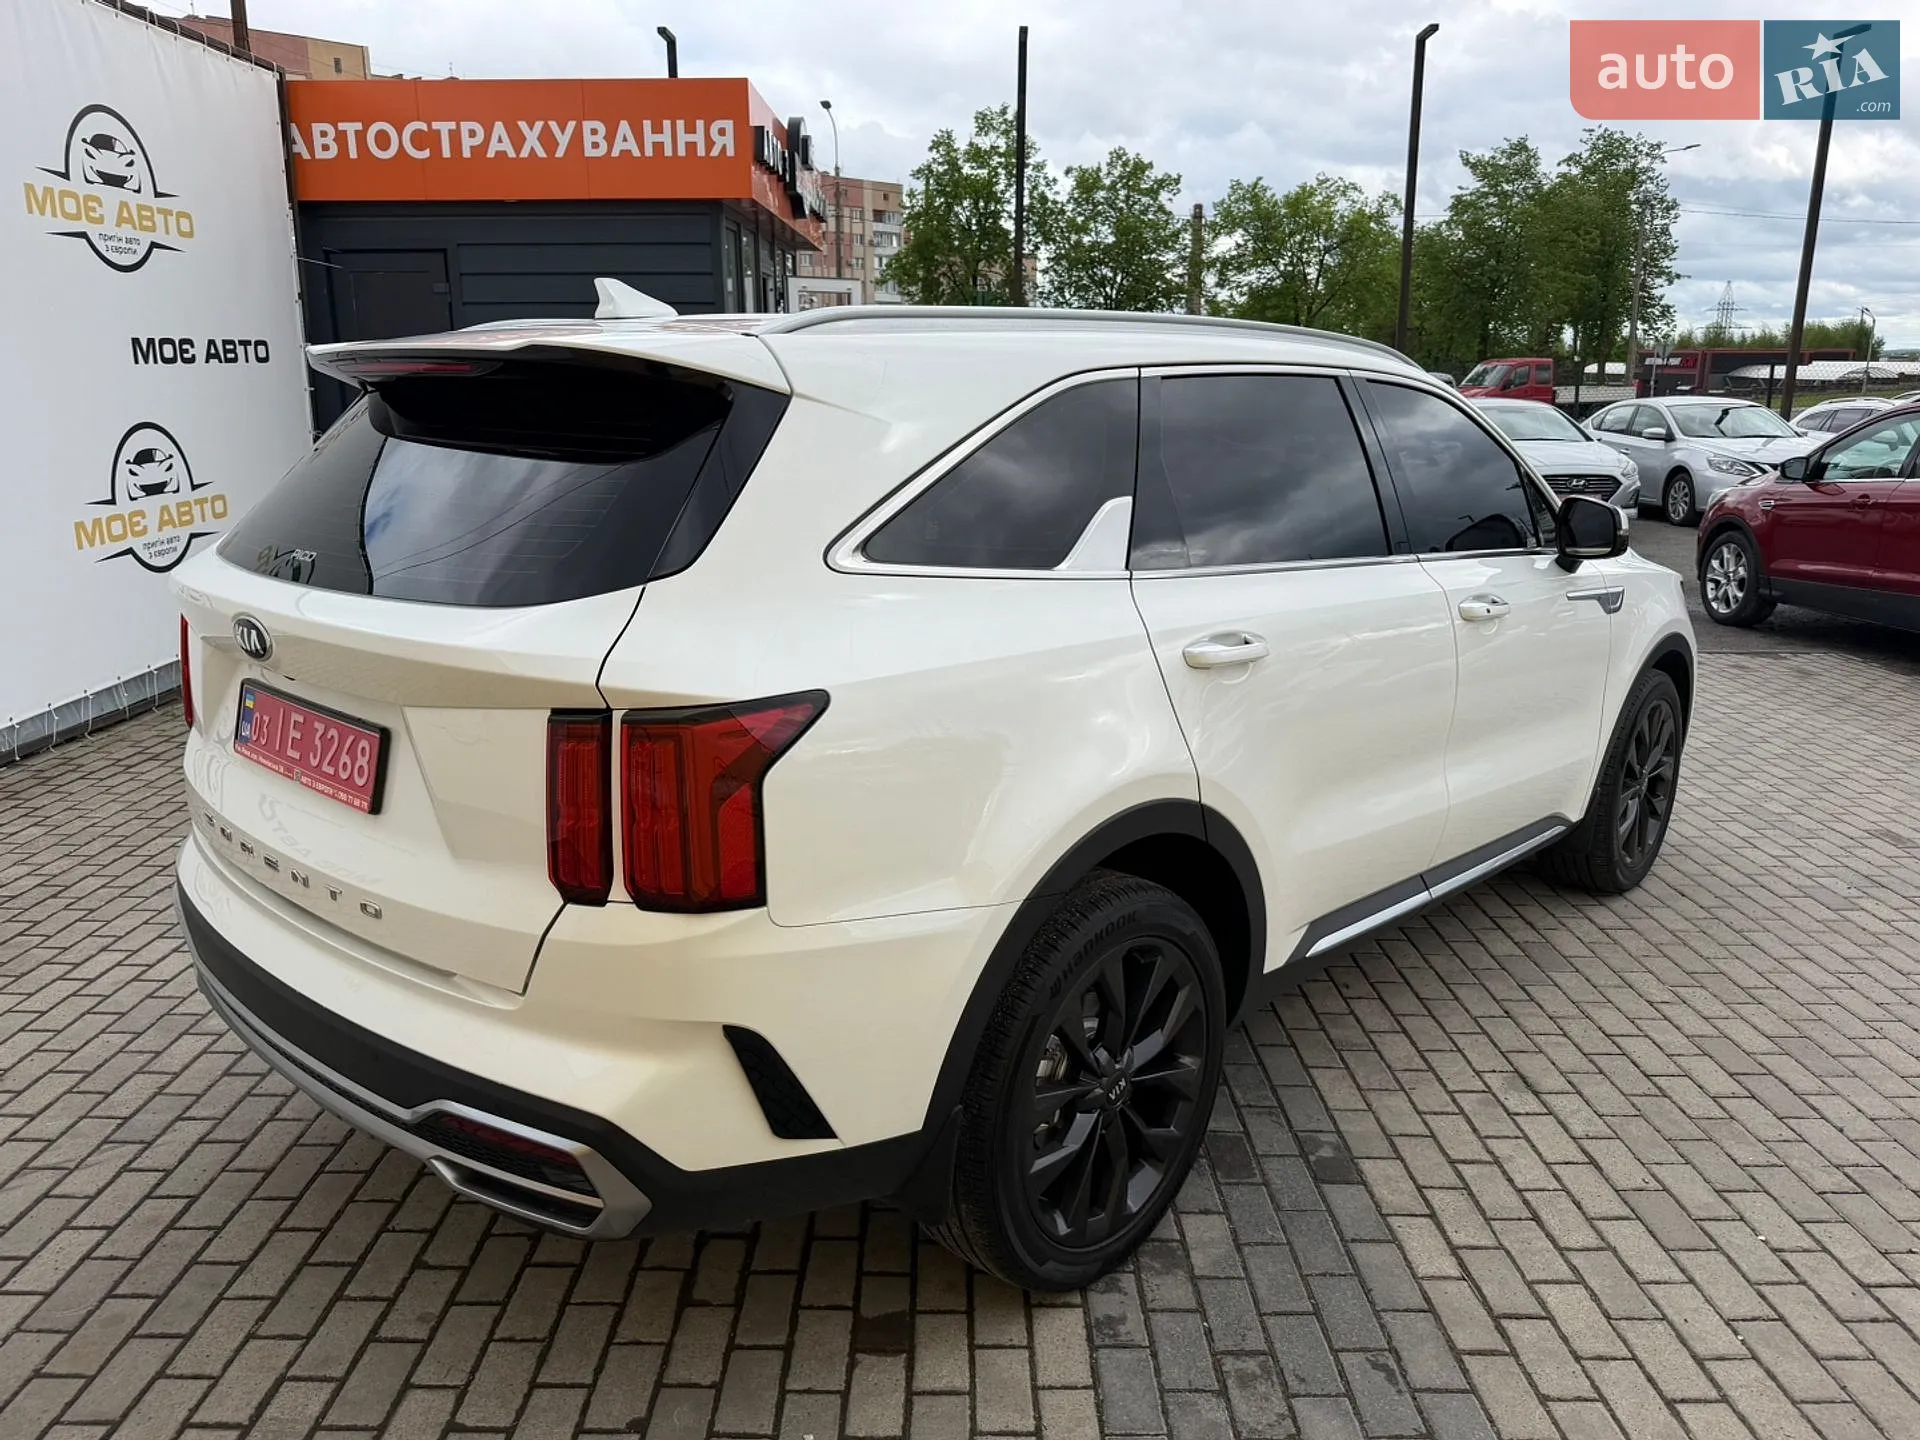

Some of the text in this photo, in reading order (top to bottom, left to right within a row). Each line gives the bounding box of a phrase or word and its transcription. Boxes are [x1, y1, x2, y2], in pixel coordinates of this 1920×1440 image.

[23, 182, 195, 239] МОЄ АВТО
[131, 337, 270, 365] МОЄ АВТО
[73, 494, 229, 551] МОЄ АВТО
[235, 625, 264, 655] KIA
[252, 711, 272, 746] 03
[309, 722, 371, 788] 3268
